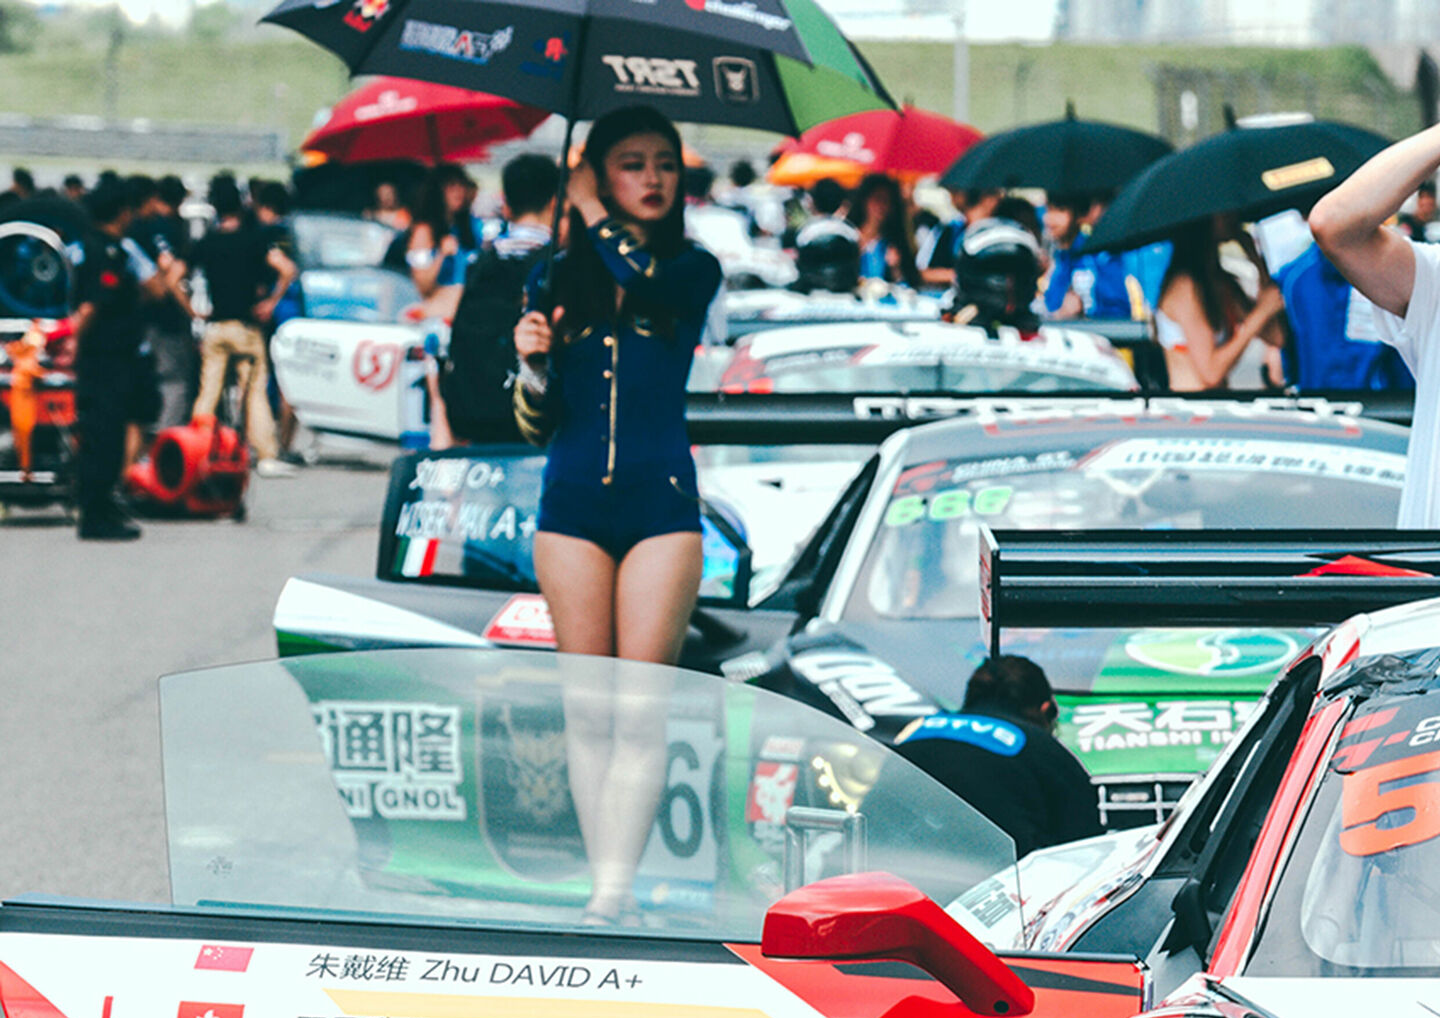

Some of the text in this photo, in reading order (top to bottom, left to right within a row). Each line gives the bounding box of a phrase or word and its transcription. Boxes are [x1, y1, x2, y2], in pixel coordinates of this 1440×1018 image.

[1078, 731, 1202, 752] TIANSHI
[305, 954, 643, 989] 朱戴维 Zhu DAVID A+
